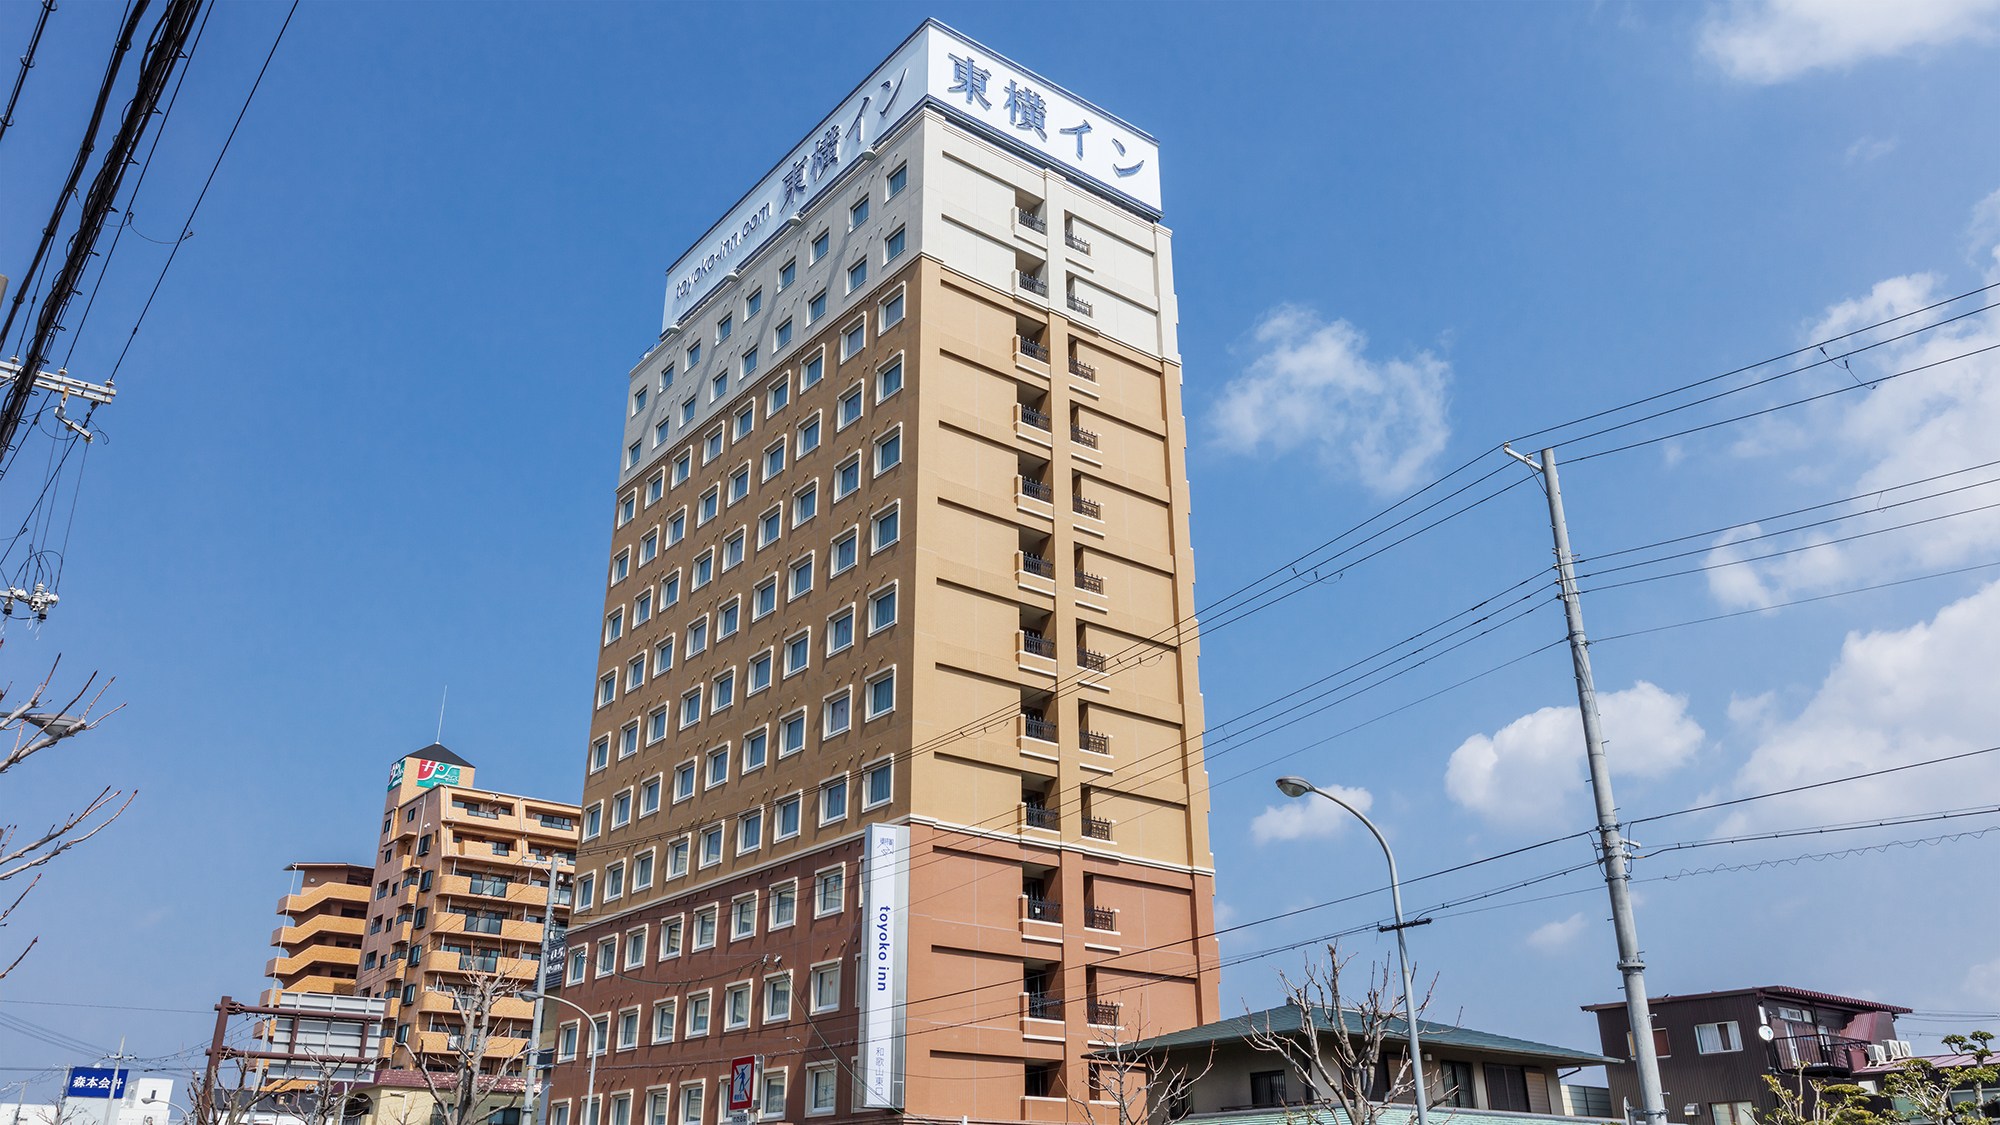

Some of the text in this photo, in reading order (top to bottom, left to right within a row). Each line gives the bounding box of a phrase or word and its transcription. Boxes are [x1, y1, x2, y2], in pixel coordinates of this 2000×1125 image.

[780, 68, 909, 215] 東横イン
[947, 52, 1145, 179] 東横イン
[676, 201, 772, 299] toyoko-inn.com
[876, 905, 891, 991] toyoko inn
[875, 1047, 885, 1096] 和歌山東口
